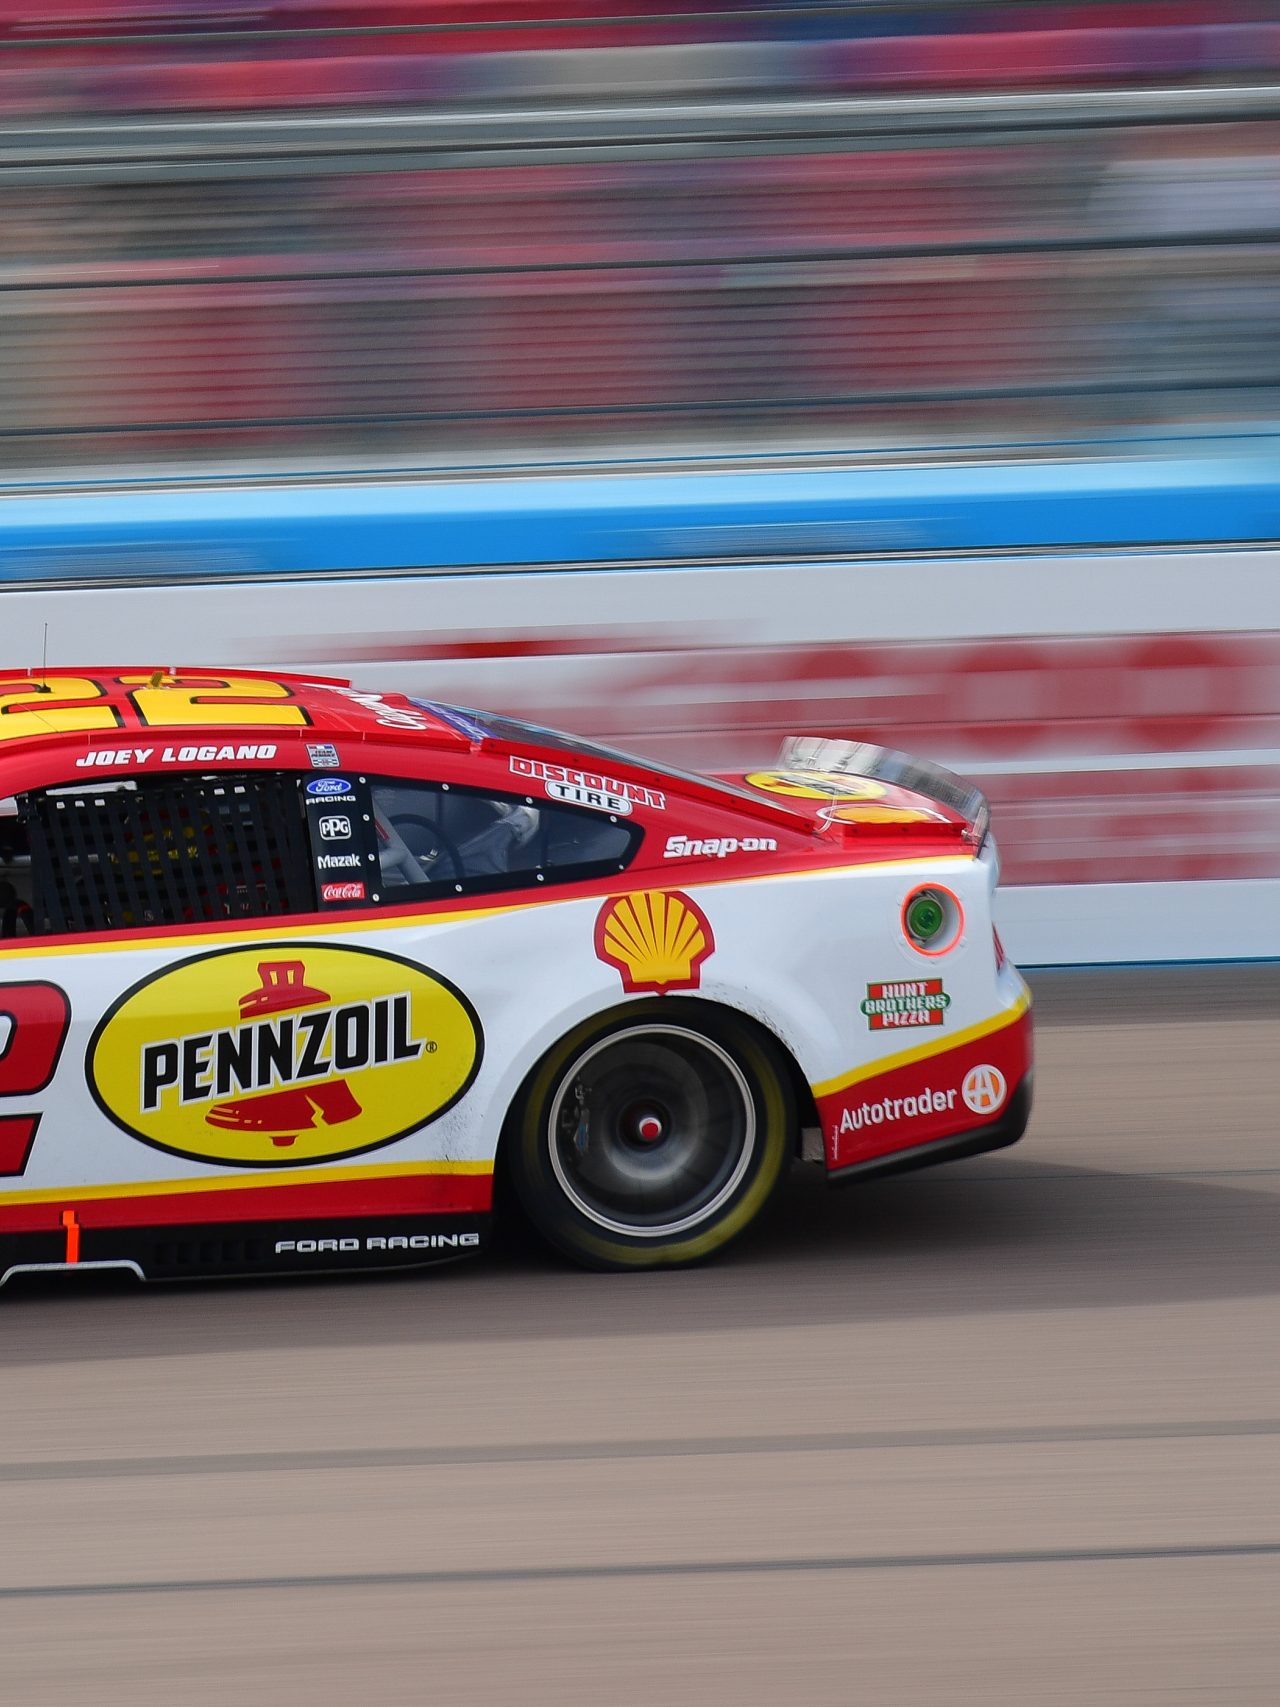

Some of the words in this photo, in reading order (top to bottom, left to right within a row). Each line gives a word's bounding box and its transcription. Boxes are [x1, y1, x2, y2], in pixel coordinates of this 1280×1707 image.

[75, 747, 154, 767] JOEY
[161, 744, 277, 763] LOGANO
[315, 780, 343, 792] Ford
[509, 755, 667, 810] DISCOUNT
[305, 795, 357, 806] RACING
[556, 784, 622, 810] TIRE
[321, 818, 349, 837] PPG
[663, 835, 778, 859] Snap-on
[317, 853, 362, 870] Mazak
[881, 981, 929, 999] HUNT
[864, 994, 947, 1013] BROTHERS
[881, 1009, 931, 1027] PIZZA
[140, 991, 428, 1114] PENNZOIL
[839, 1087, 958, 1135] Autotrader
[275, 1238, 360, 1254] FORD
[366, 1232, 480, 1250] RACING
